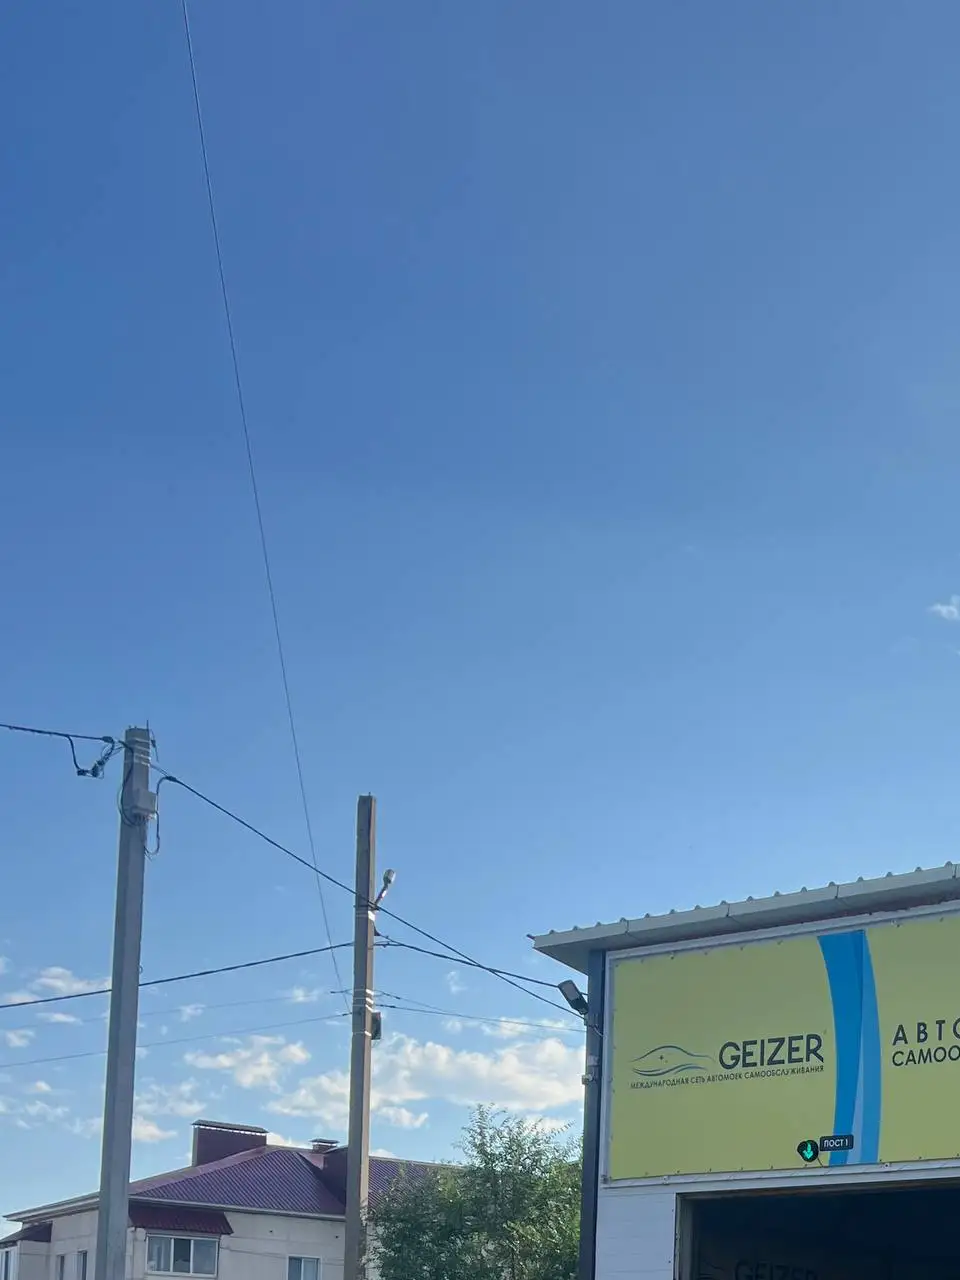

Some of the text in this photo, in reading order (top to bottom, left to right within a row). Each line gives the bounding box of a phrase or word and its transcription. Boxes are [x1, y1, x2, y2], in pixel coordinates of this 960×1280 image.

[718, 1033, 825, 1070] GEIZER
[630, 1065, 825, 1090] МЕЖДУНАРОДНАЯ СЕТЬ АВТОМОЕК САМООБСЛУЖИВАНИЯ
[823, 1139, 844, 1148] ПОСТ
